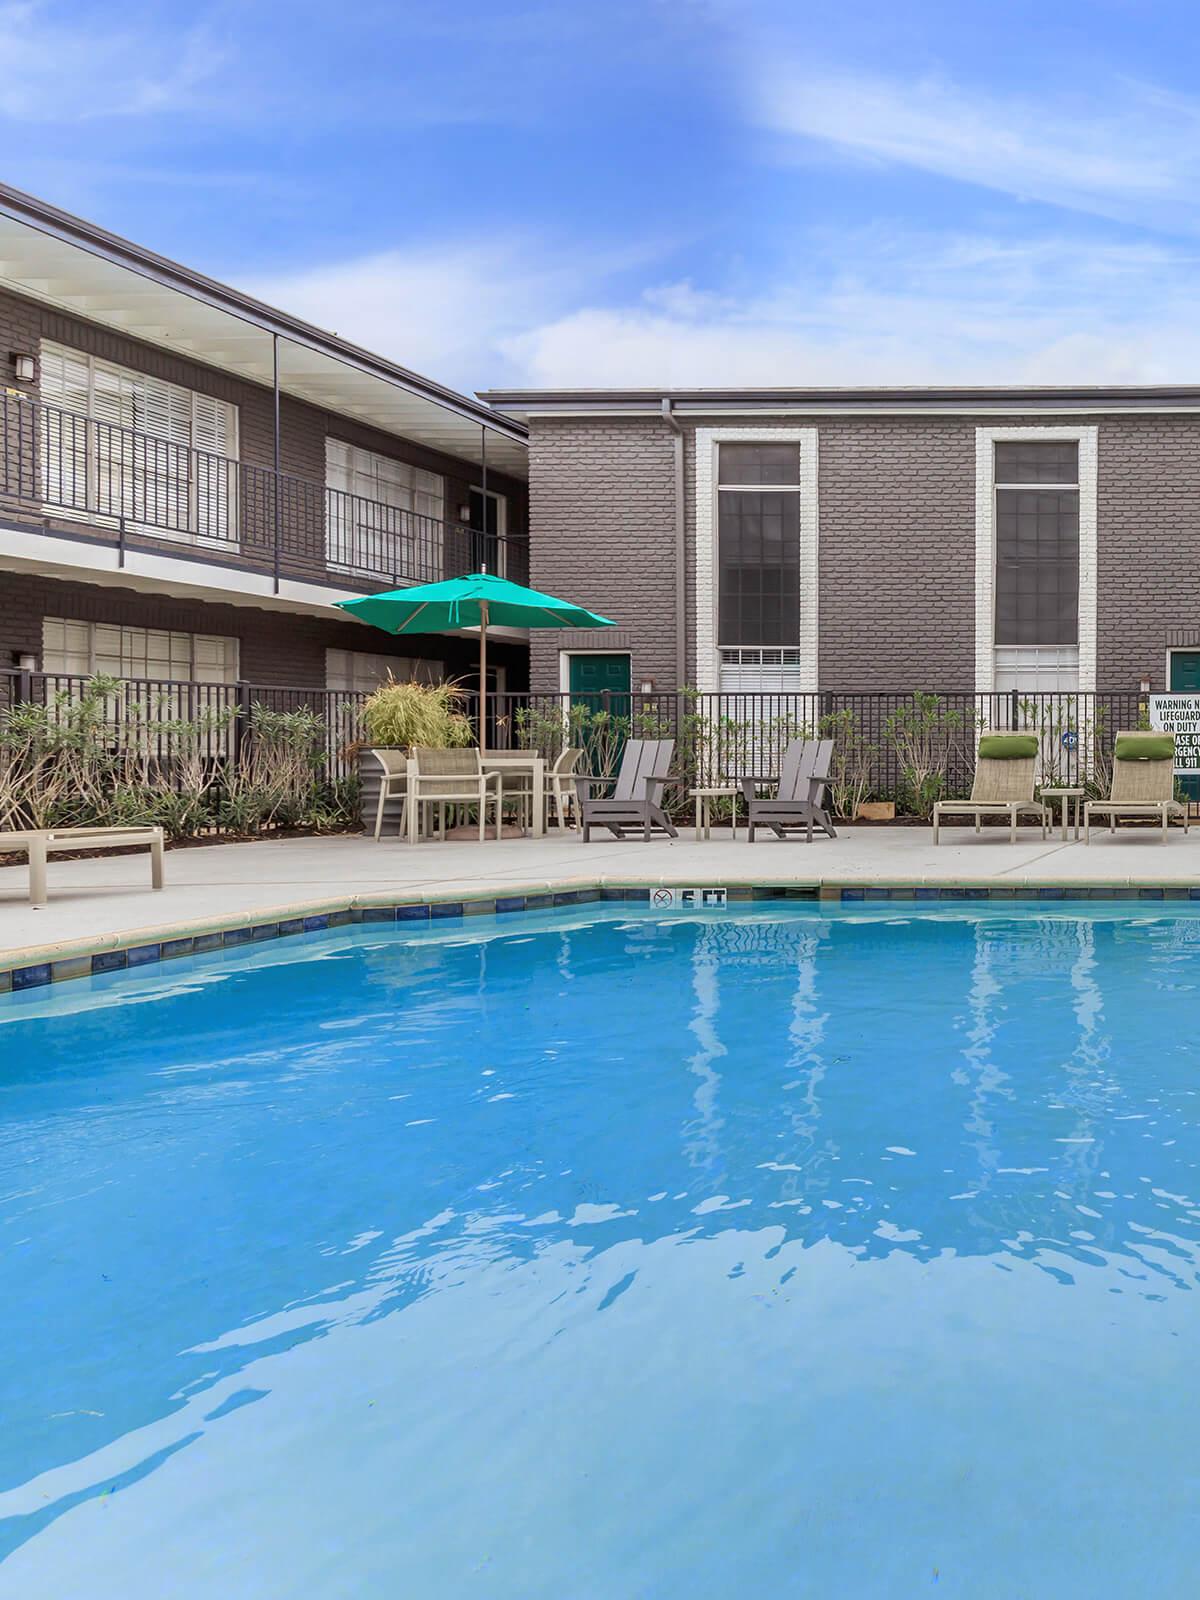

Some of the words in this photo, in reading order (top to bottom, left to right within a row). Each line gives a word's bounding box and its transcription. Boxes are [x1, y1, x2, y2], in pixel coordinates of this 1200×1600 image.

[1155, 699, 1192, 710] WARNING
[1159, 711, 1200, 721] LIFEGUARD
[1163, 722, 1175, 732] ON
[1176, 722, 1198, 732] DUTY
[1175, 735, 1190, 746] ASE
[1185, 757, 1198, 768] 911
